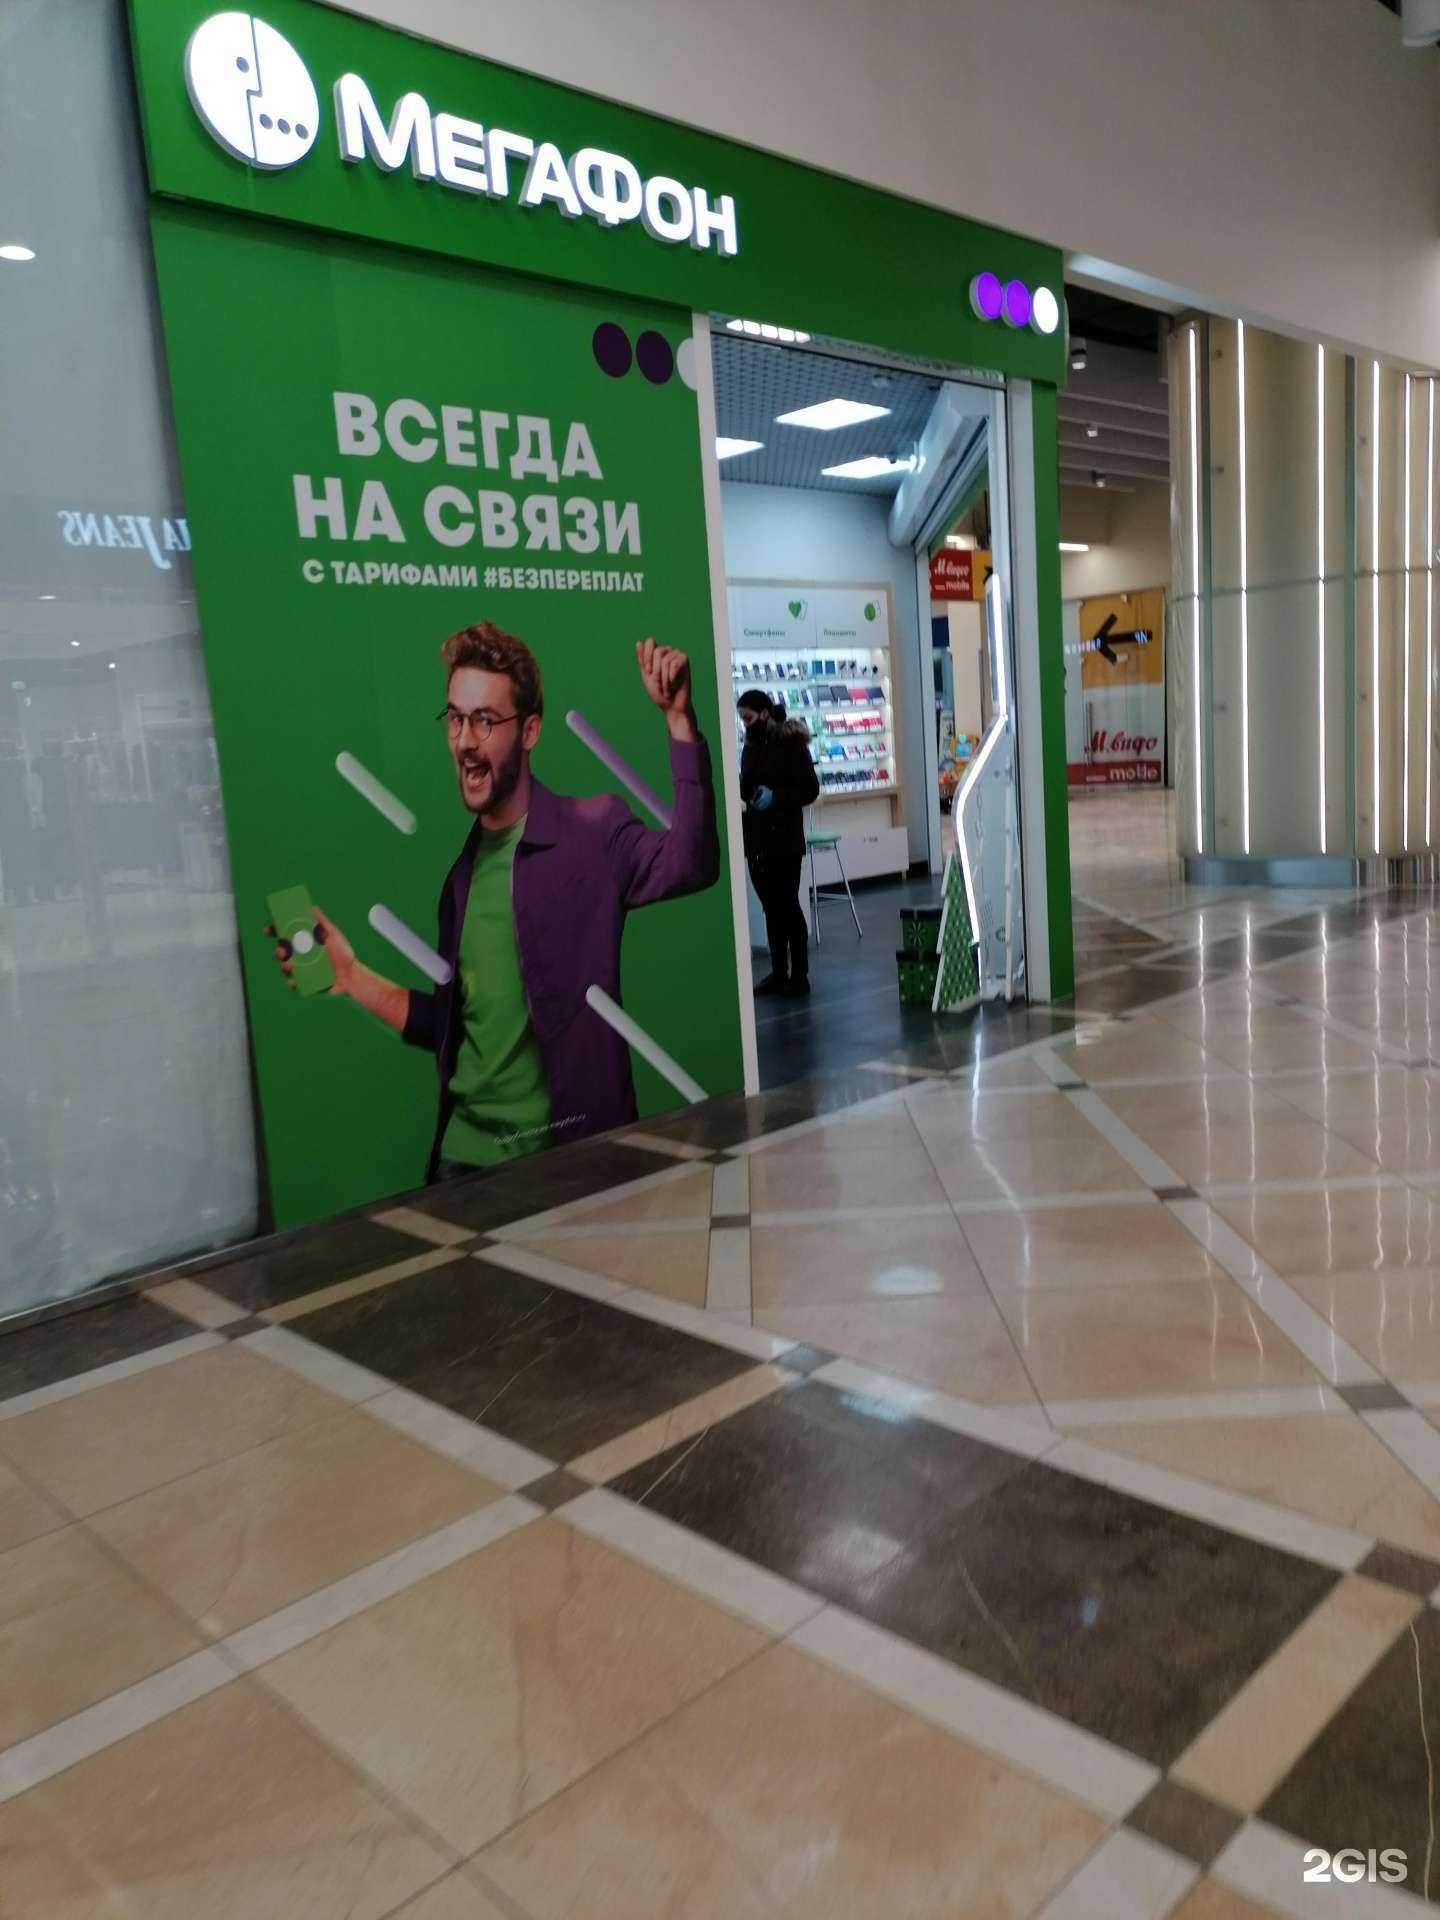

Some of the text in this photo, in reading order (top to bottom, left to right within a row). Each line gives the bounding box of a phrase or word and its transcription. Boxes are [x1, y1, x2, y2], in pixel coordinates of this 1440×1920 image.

[333, 73, 738, 256] МЕГАФОН
[333, 391, 604, 483] ВСЕГДА
[293, 474, 642, 555] НА СВЯЗИ
[302, 559, 645, 593] С ТАРИФАМИ #БЕЗПЕРЕПЛАТ
